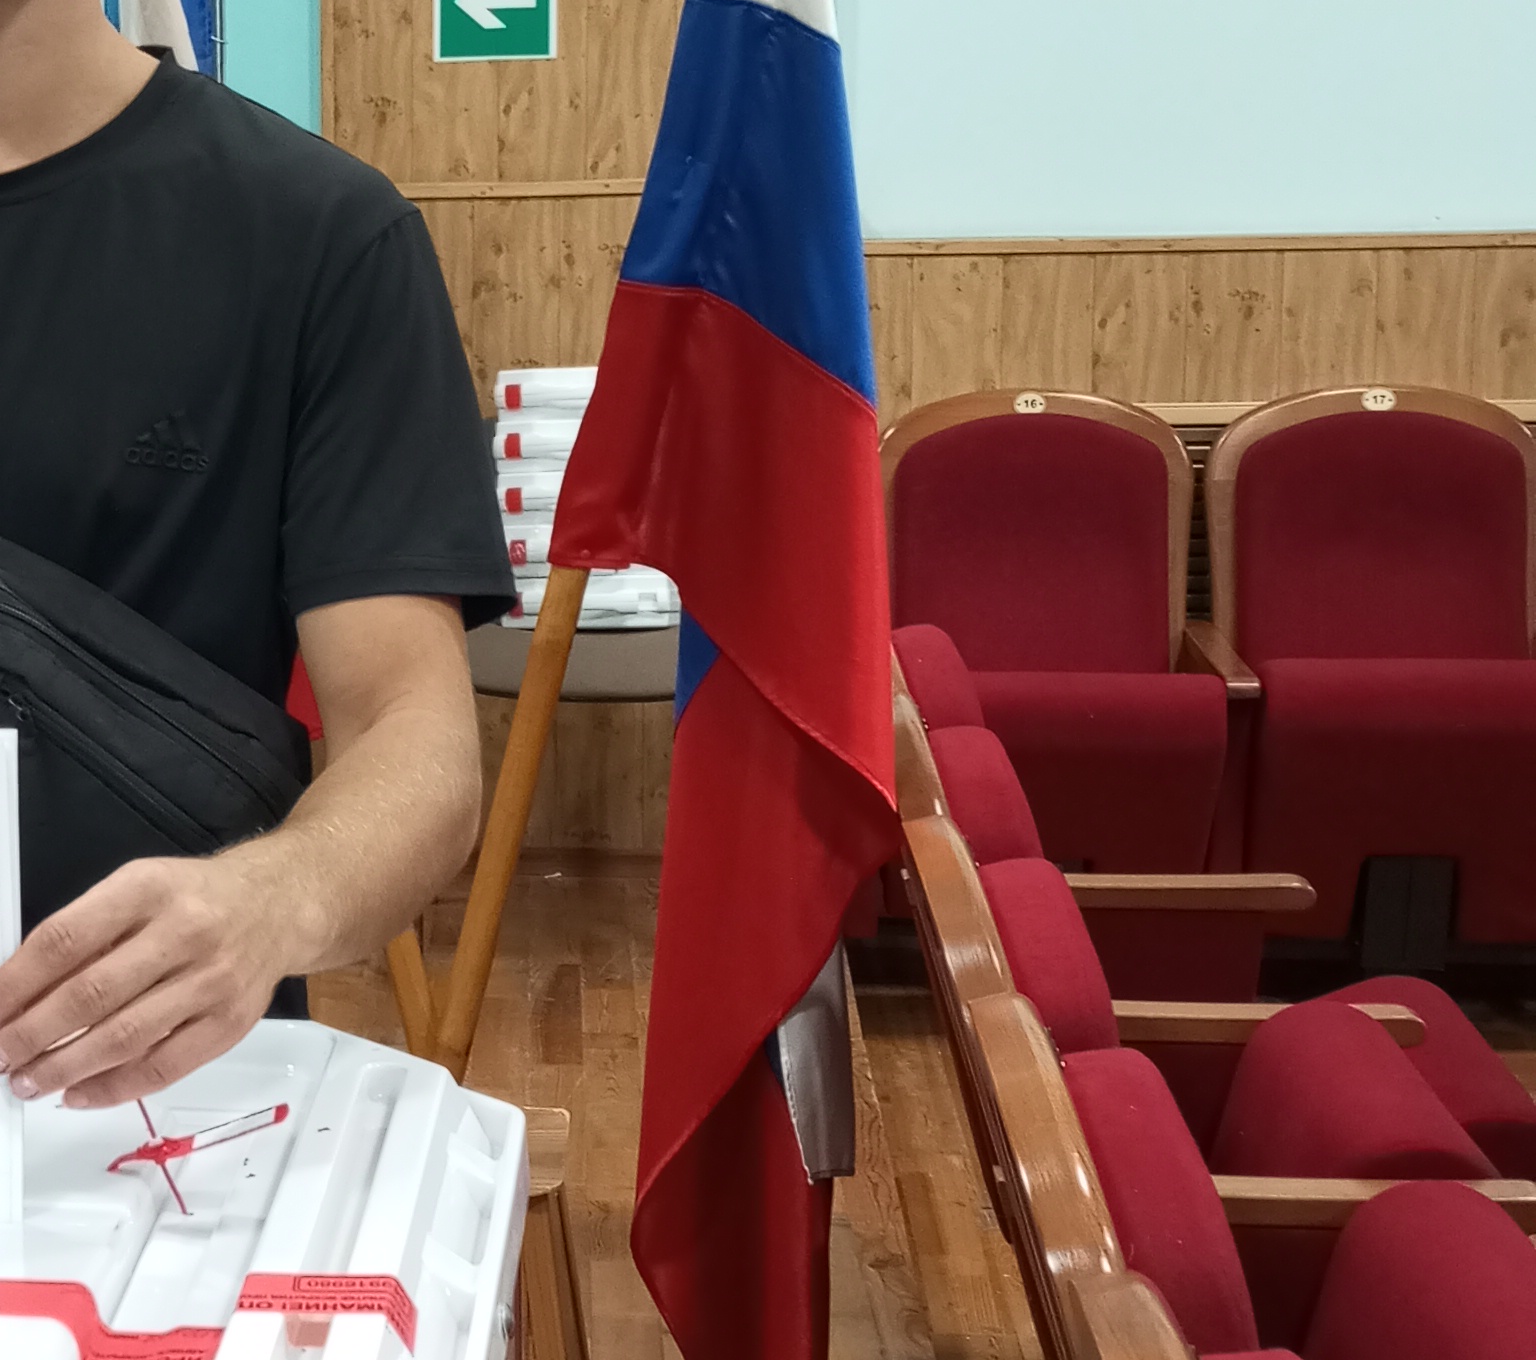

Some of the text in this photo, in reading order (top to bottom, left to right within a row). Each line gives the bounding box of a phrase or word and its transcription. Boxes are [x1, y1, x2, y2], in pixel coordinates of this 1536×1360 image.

[1024, 399, 1037, 409] 16
[1373, 395, 1386, 404] 17
[124, 444, 210, 473] adidas
